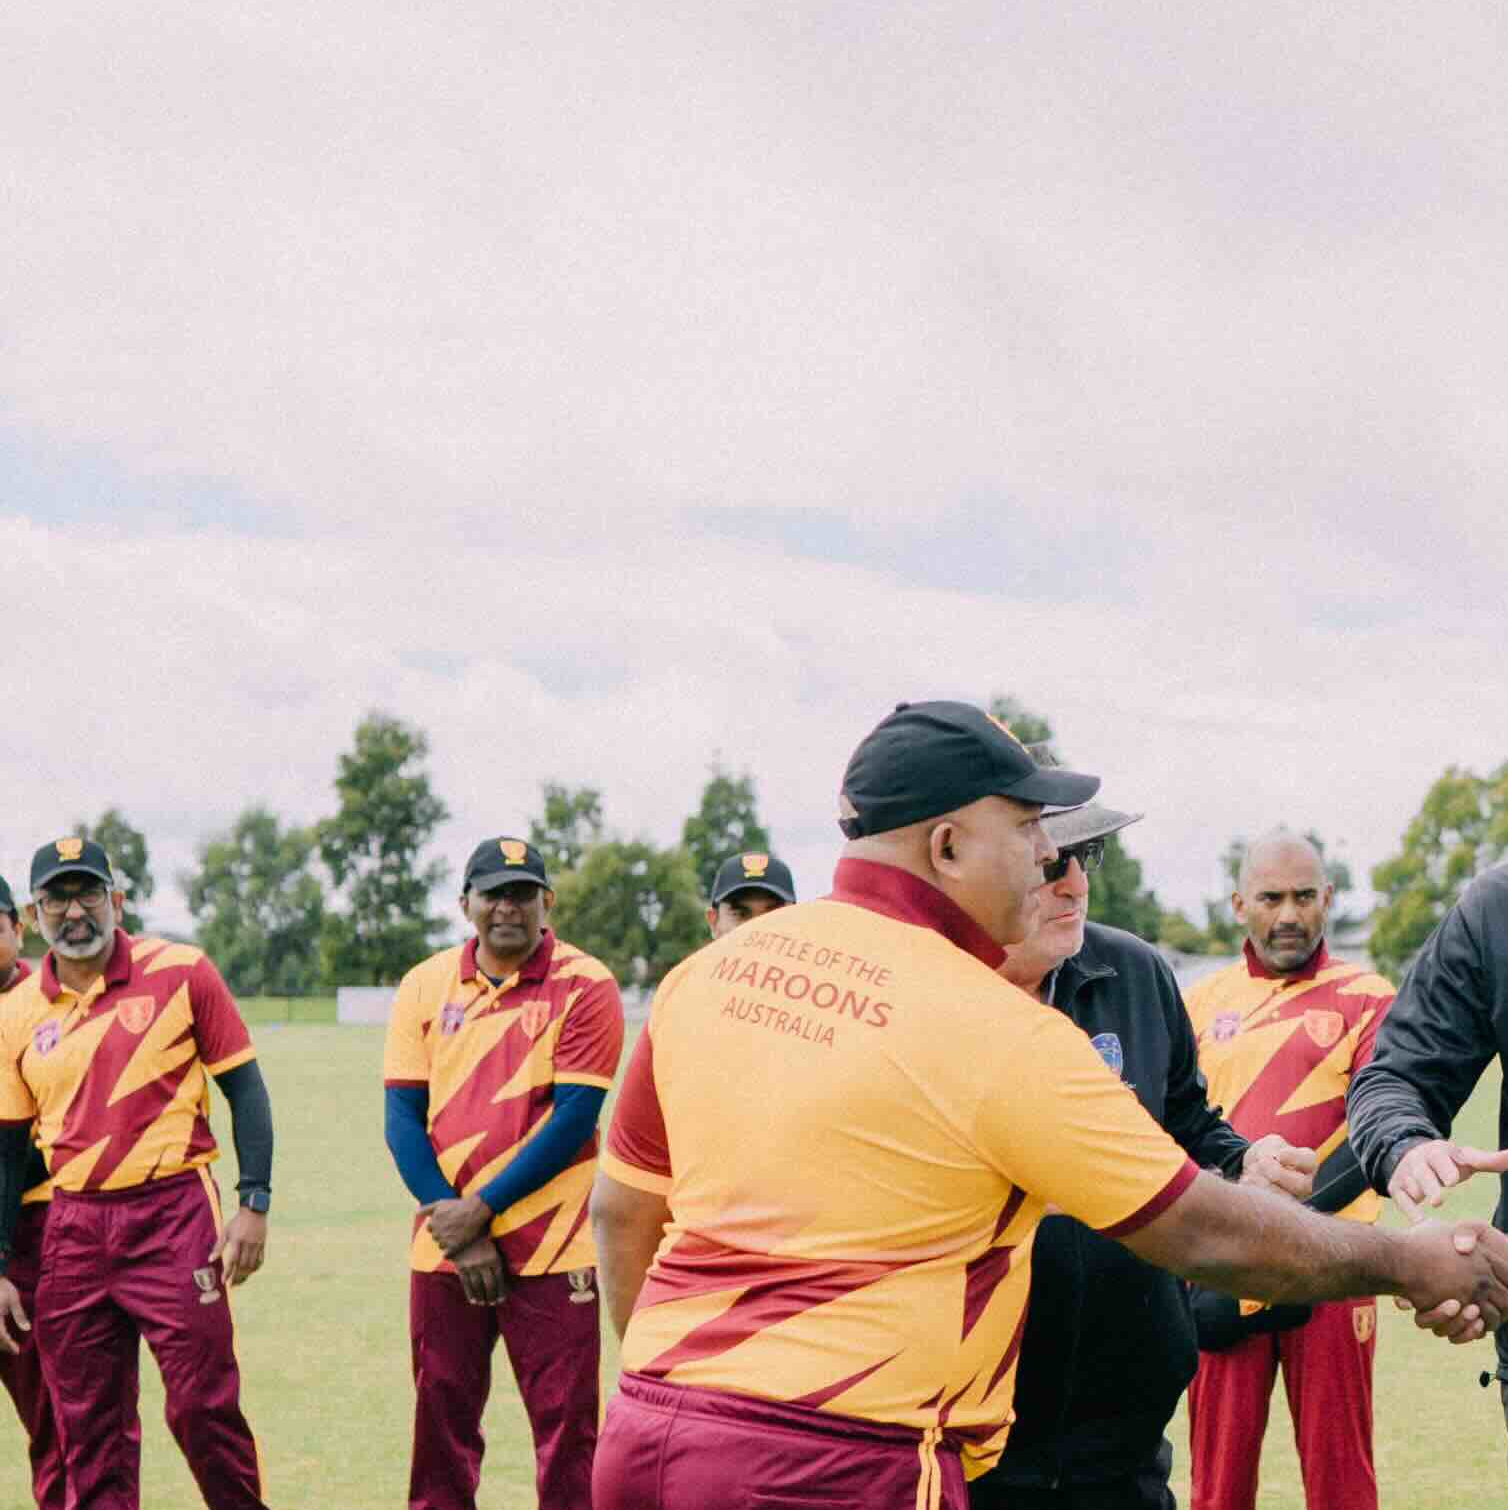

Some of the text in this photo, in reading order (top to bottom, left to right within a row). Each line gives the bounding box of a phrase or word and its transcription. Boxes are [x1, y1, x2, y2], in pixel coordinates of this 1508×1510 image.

[744, 931, 893, 987] BATTLE OF THE
[710, 956, 894, 1028] MAROONS
[721, 996, 836, 1048] AUSTRALIA
